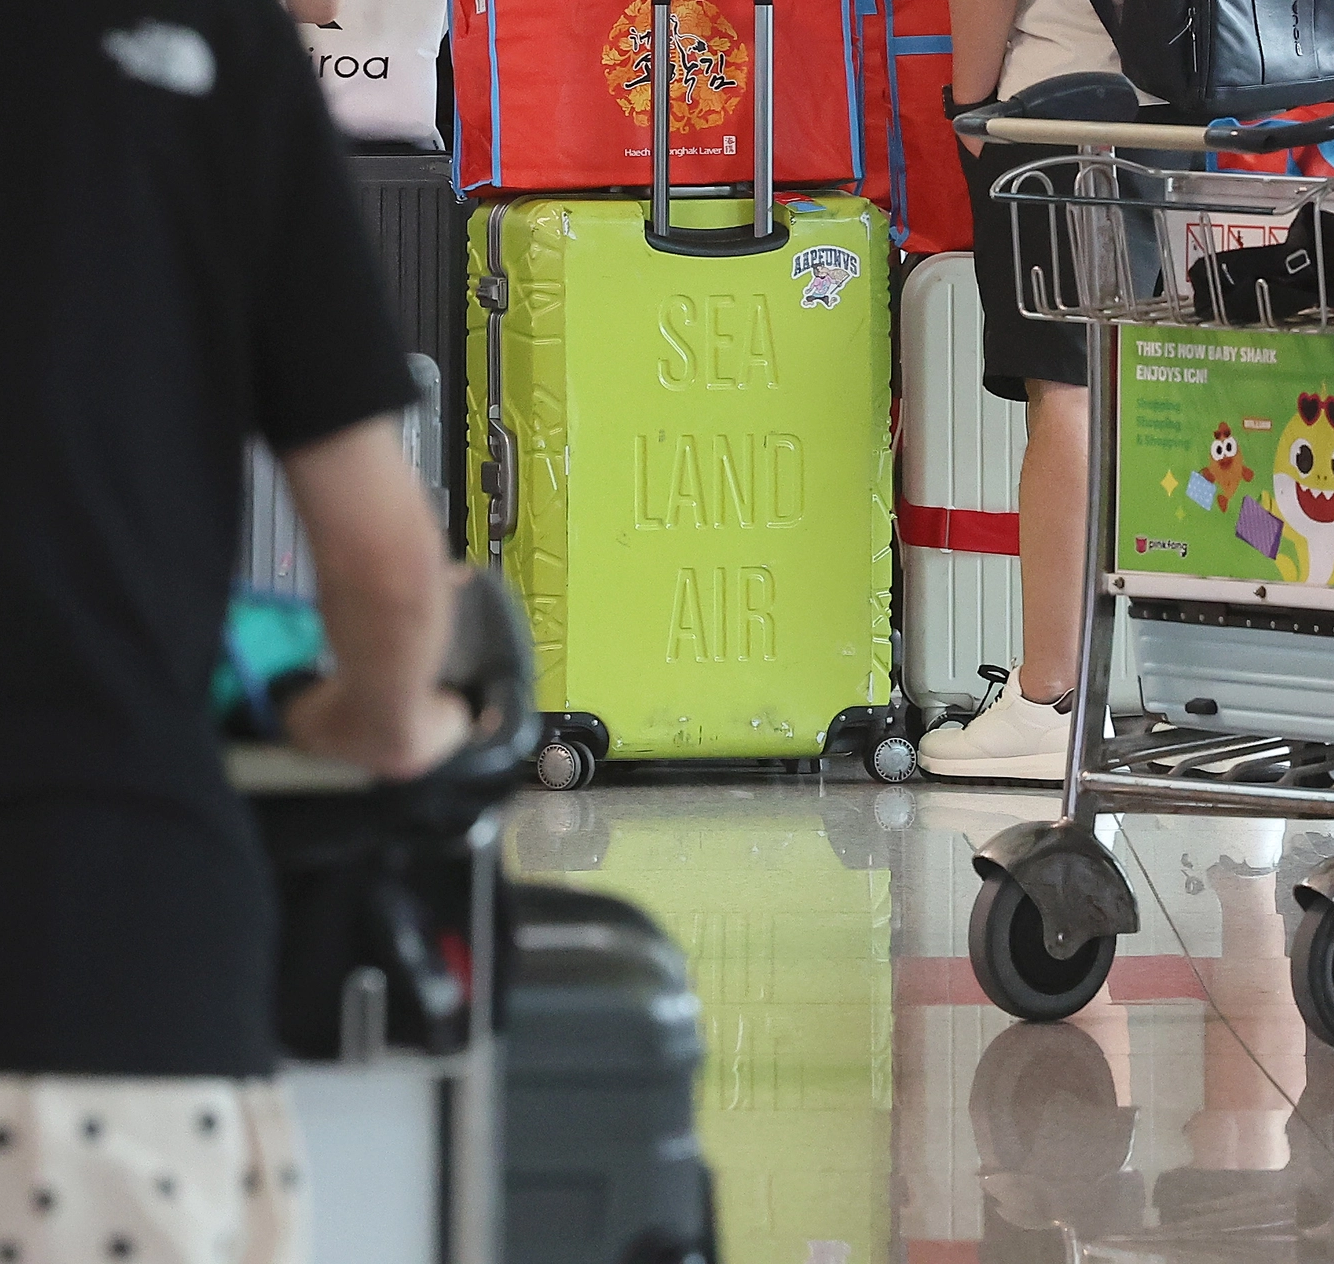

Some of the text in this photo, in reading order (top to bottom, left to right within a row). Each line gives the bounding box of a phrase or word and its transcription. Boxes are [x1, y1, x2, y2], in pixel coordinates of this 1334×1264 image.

[699, 147, 723, 156] Laver
[657, 293, 779, 391] SEA
[1136, 340, 1278, 364] THIS IS HOW BABY SHARK
[1136, 365, 1182, 382] ENJOYS
[634, 432, 805, 531] LAND
[1148, 539, 1188, 558] pinkfong
[666, 565, 779, 663] AIR
